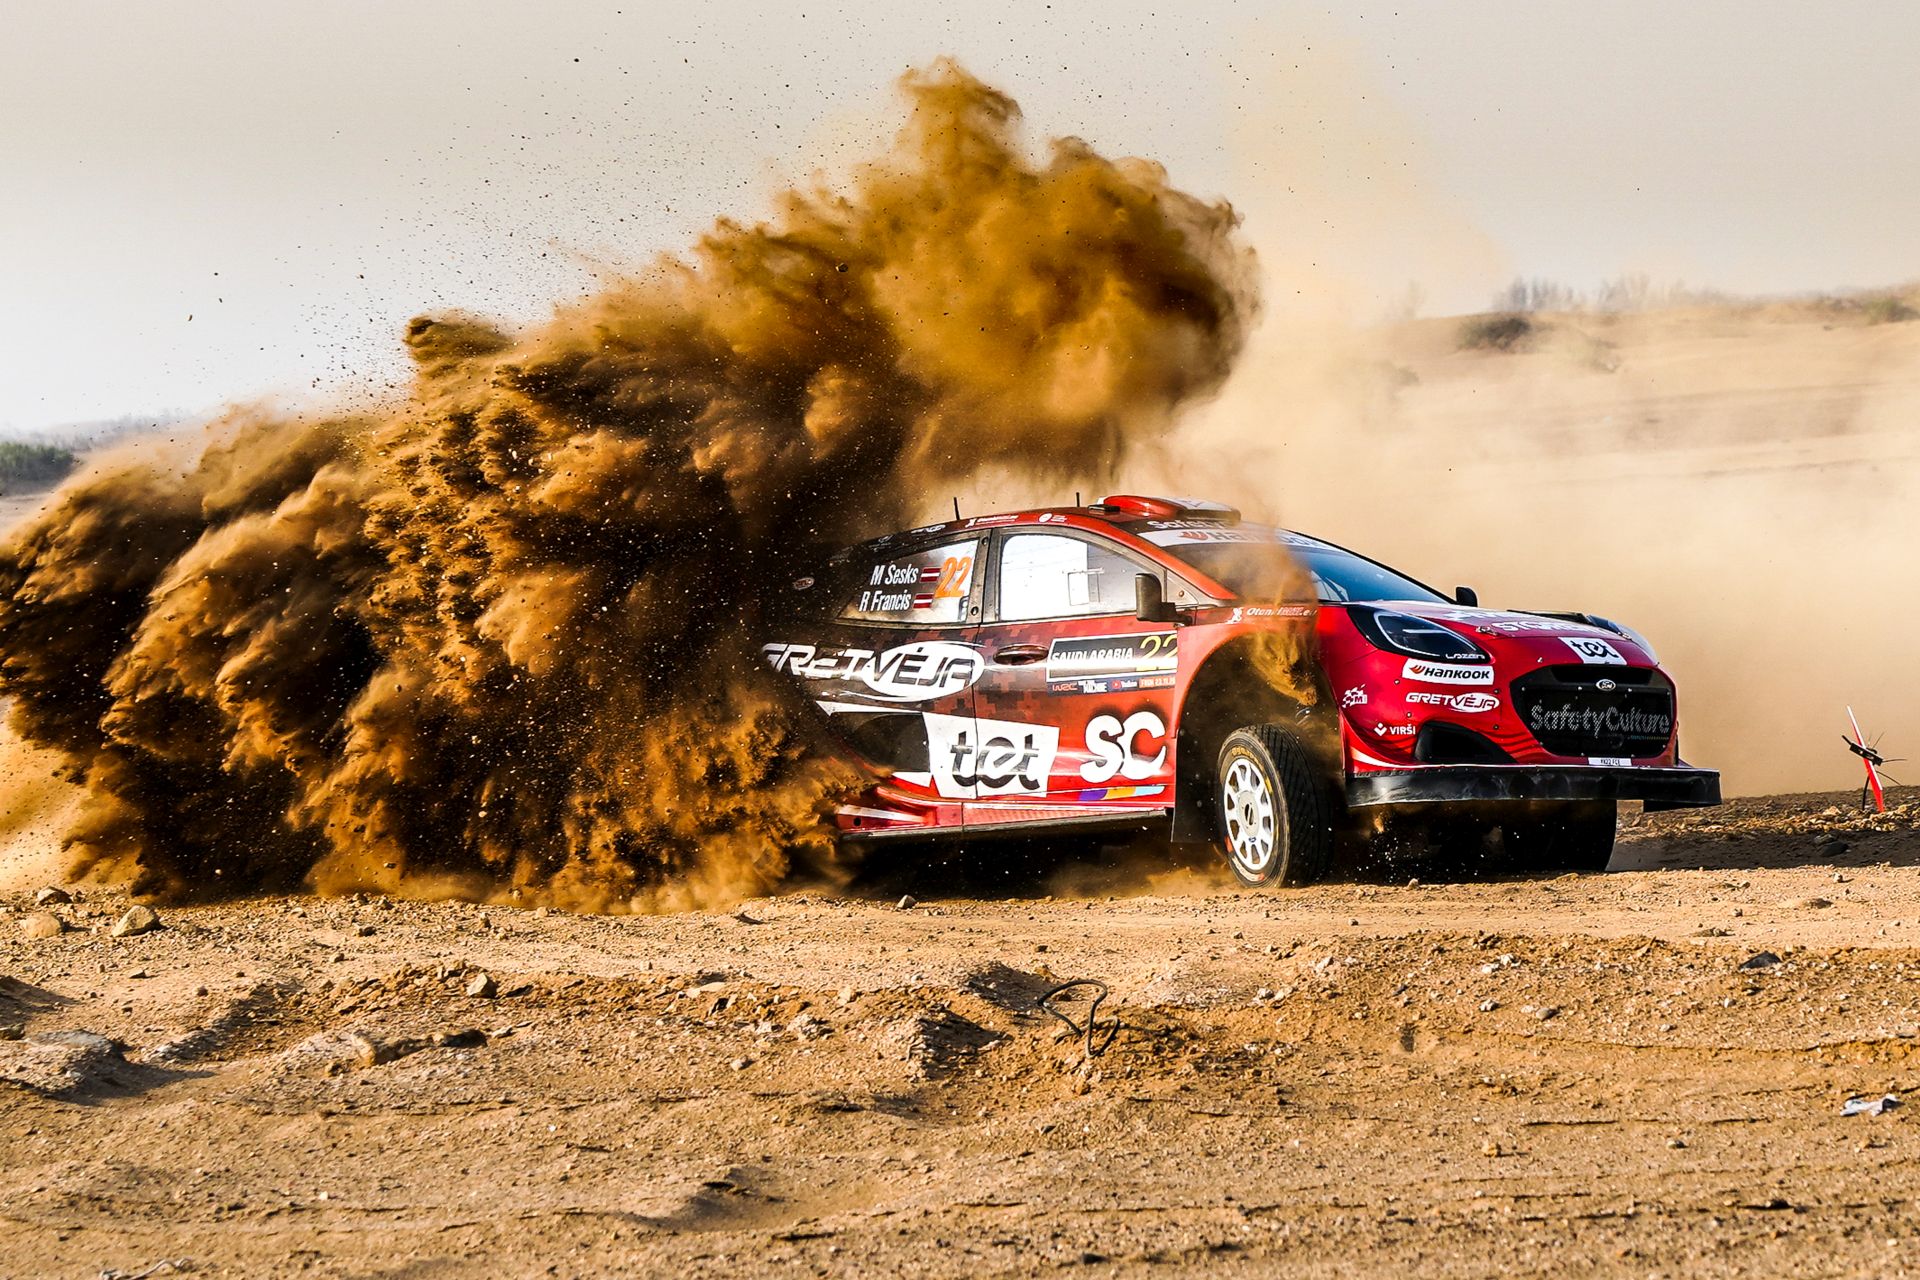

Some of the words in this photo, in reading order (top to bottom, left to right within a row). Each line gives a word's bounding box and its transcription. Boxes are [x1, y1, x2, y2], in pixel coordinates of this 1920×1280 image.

[869, 565, 885, 585] M
[885, 563, 919, 585] Sesks
[934, 557, 972, 599] 22
[859, 591, 870, 612] R
[870, 589, 911, 612] Francis
[1089, 647, 1134, 661] ARABIA
[1571, 638, 1619, 659] tet
[1052, 682, 1078, 691] WRC
[1389, 723, 1416, 735] VIRŠI
[1530, 703, 1670, 738] SafetyCulture
[1080, 711, 1167, 783] SC
[950, 731, 1041, 790] tet
